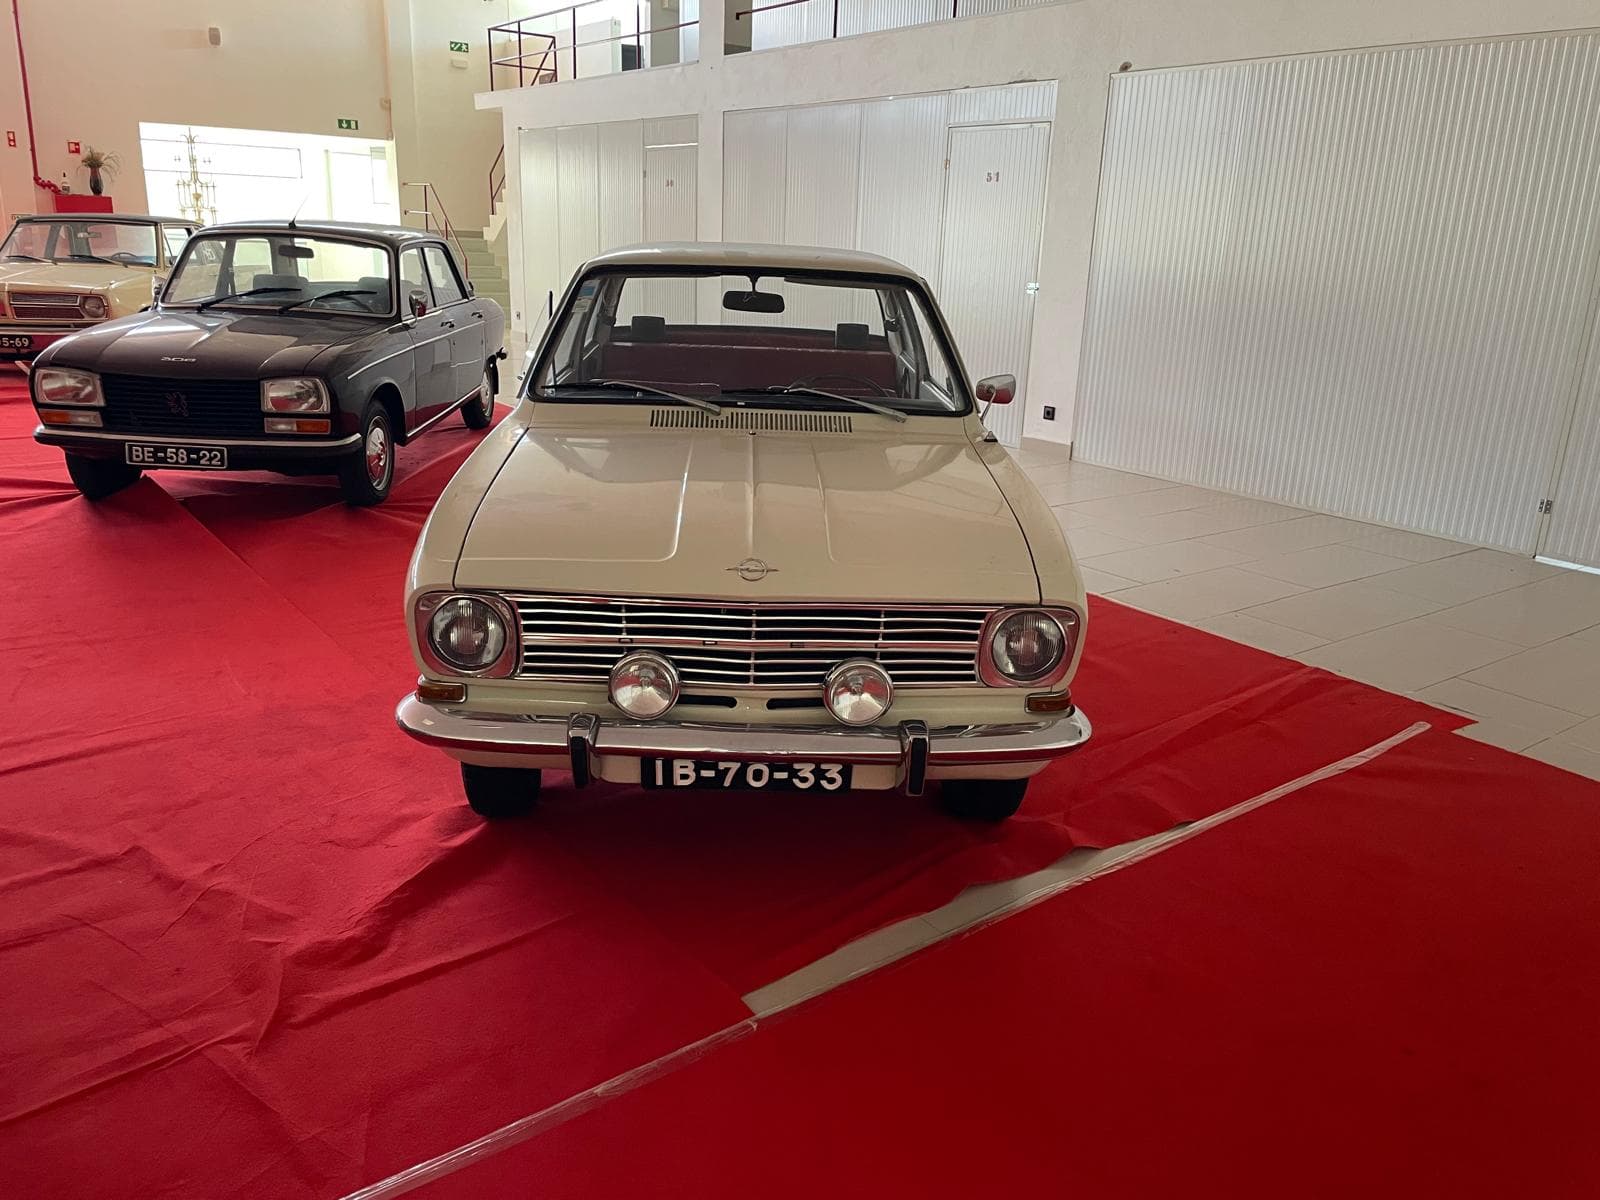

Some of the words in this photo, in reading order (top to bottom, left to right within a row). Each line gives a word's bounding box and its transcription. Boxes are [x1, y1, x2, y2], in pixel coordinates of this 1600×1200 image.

[0, 337, 29, 347] 5-69
[132, 446, 221, 465] BE-58-22
[655, 758, 843, 790] IB-70-33
